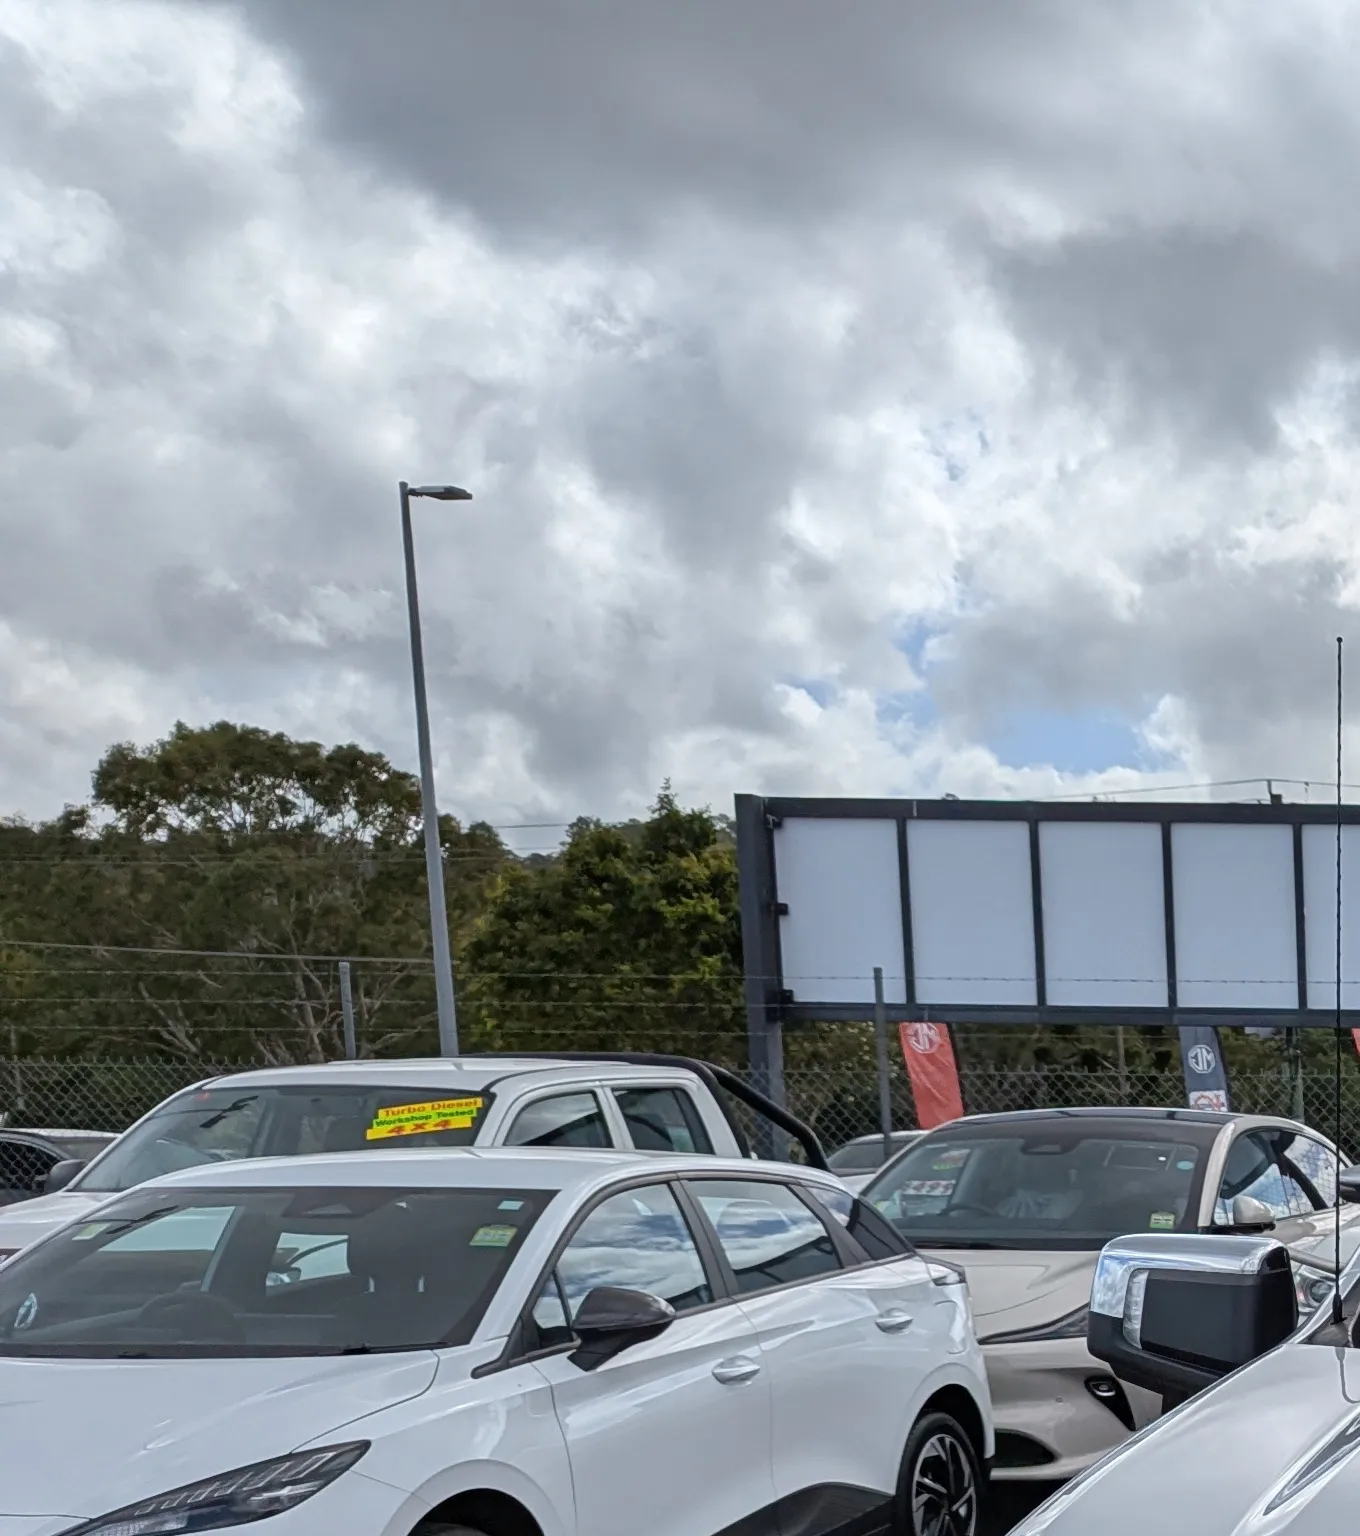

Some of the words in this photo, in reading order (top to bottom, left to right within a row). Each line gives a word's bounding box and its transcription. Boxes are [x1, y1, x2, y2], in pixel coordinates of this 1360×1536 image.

[375, 1114, 432, 1126] Workshop
[436, 1108, 474, 1118] Tested
[384, 1105, 426, 1117] Turbo
[431, 1099, 478, 1110] Diesel
